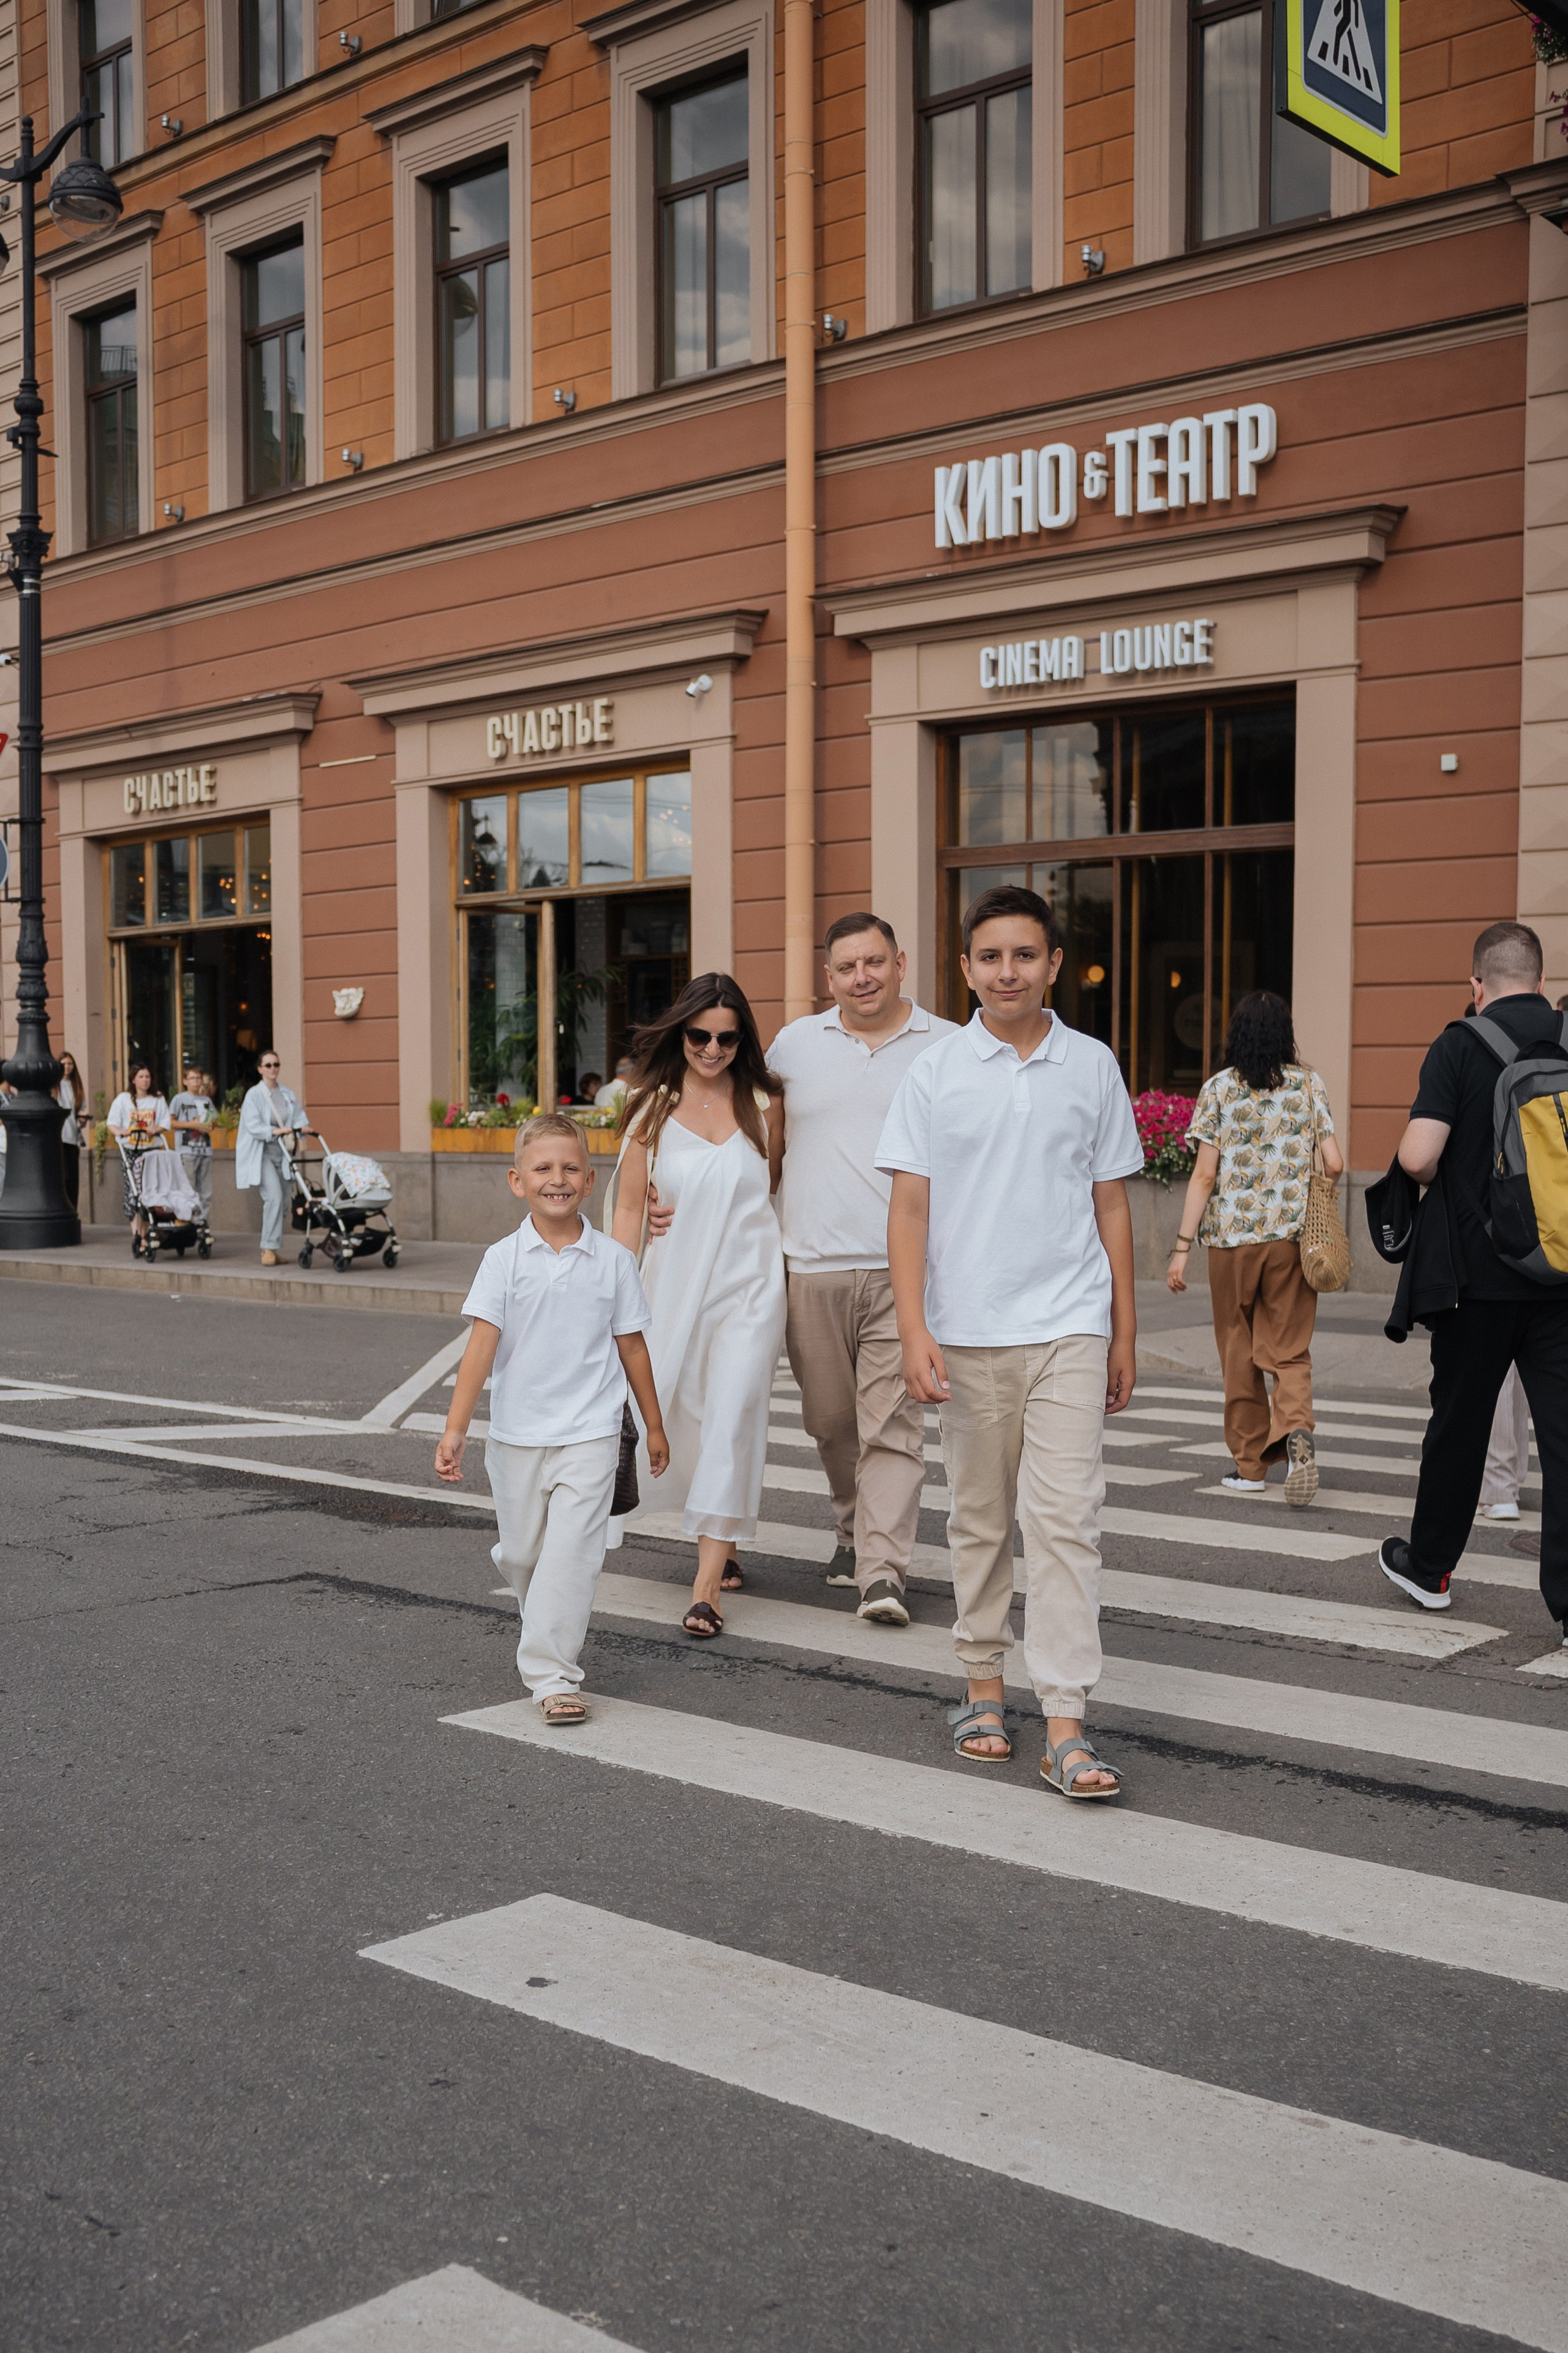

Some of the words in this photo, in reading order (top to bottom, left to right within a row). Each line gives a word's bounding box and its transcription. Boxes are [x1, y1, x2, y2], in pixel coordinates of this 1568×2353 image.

[980, 635, 1085, 689] CINEMA
[1100, 618, 1215, 675] LOUNGE
[487, 698, 612, 759] СЧАСТЬЕ
[124, 765, 216, 814] СЧАСТЬЕ
